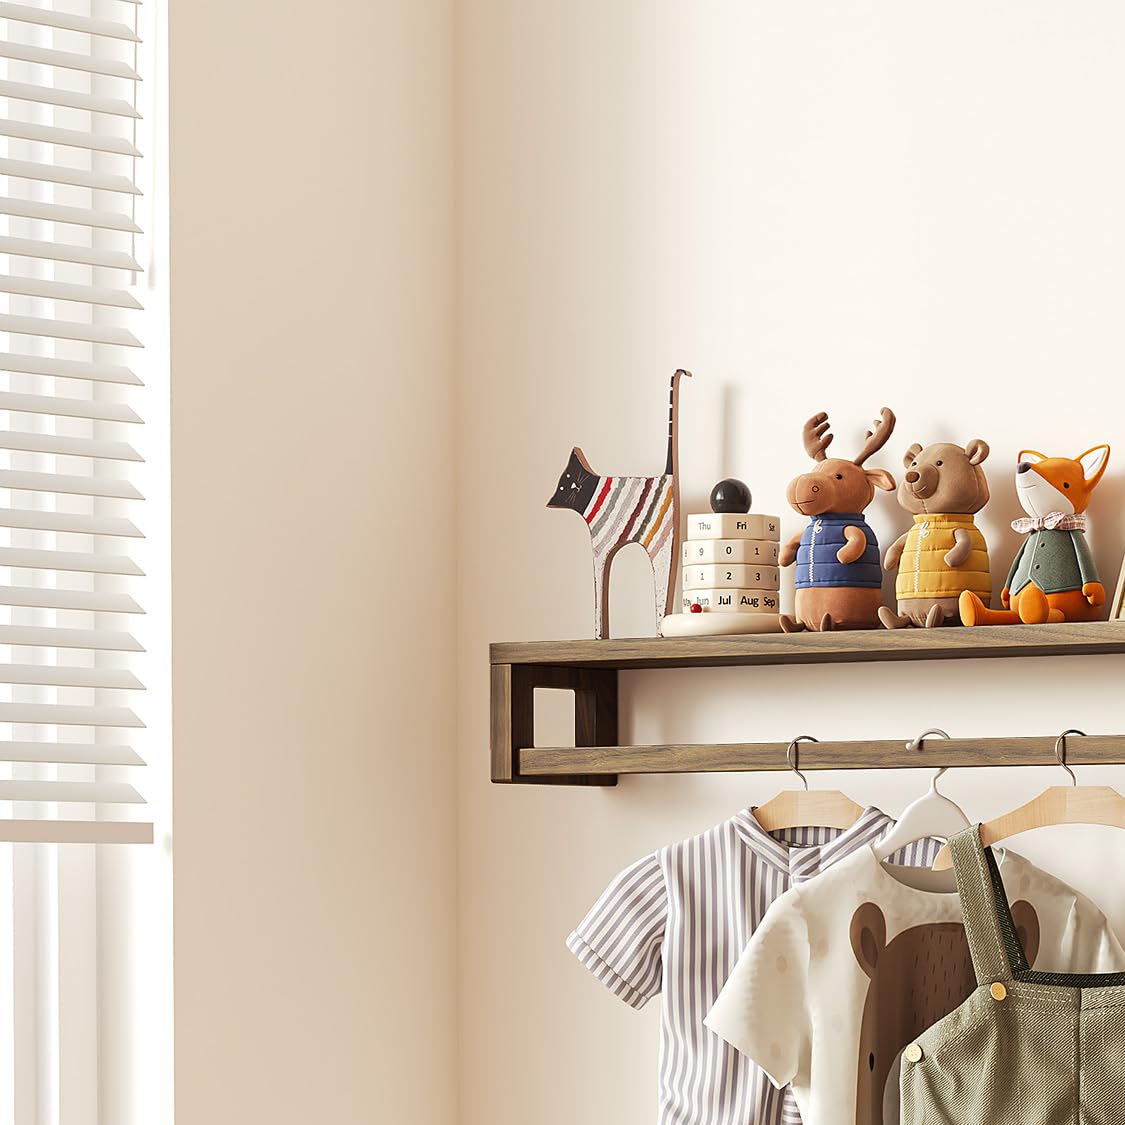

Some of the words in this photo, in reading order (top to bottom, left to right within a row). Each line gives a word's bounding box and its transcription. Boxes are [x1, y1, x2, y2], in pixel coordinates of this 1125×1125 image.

[698, 522, 712, 530] Thu
[736, 522, 747, 530] Fri
[699, 547, 704, 556] 9
[726, 546, 732, 555] 0
[755, 547, 760, 555] 1
[700, 572, 705, 581] 1
[726, 572, 732, 580] 2
[755, 572, 761, 581] 3
[718, 595, 731, 605] Jul
[740, 595, 759, 608] Aug
[763, 596, 775, 608] Sep
